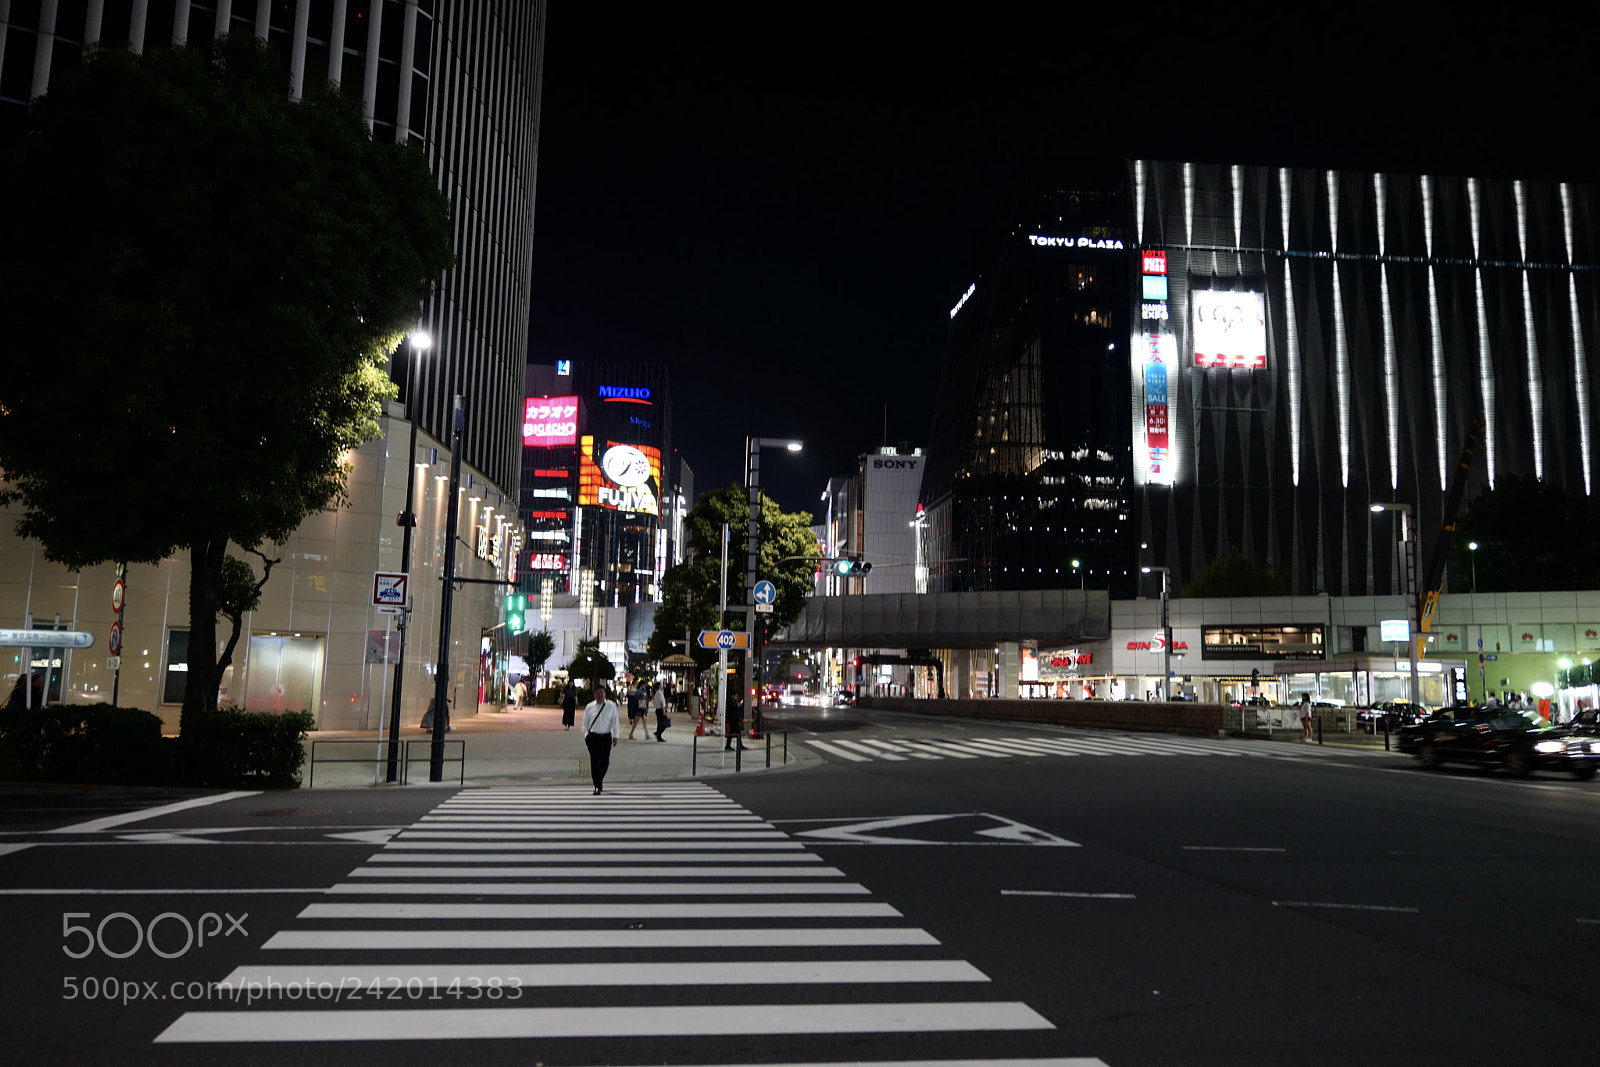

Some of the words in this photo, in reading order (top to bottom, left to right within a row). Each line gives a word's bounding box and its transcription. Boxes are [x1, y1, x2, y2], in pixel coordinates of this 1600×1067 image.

[1029, 235, 1074, 247] TOKYU
[1077, 237, 1123, 249] PLAZA
[598, 385, 651, 399] MIZUHO
[1148, 395, 1166, 403] SALE
[526, 405, 577, 419] カラオケ
[873, 459, 917, 469] SONY
[718, 634, 734, 646] 402
